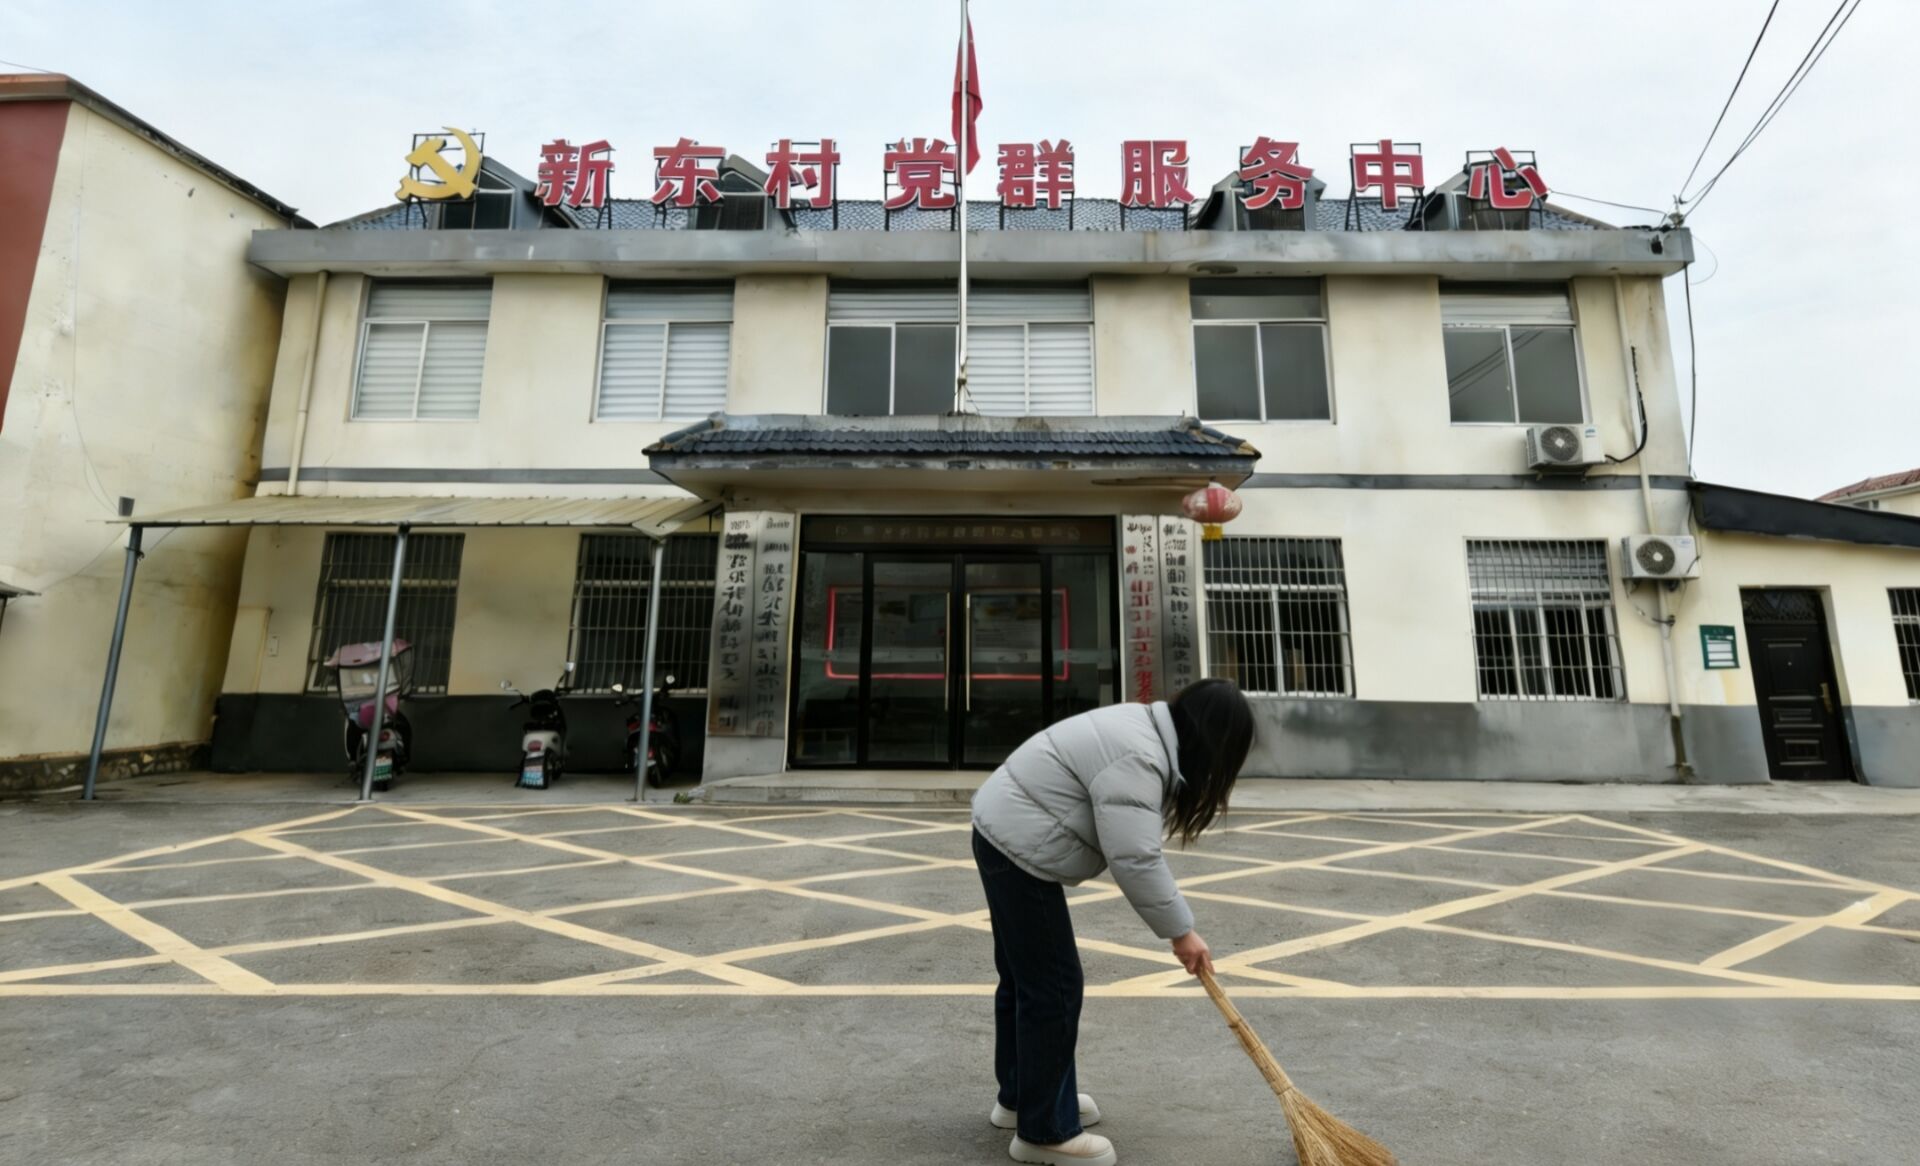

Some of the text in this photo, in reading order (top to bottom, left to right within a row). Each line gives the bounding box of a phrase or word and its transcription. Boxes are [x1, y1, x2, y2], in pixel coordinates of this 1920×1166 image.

[537, 136, 1548, 211] 新东村党群服务中心
